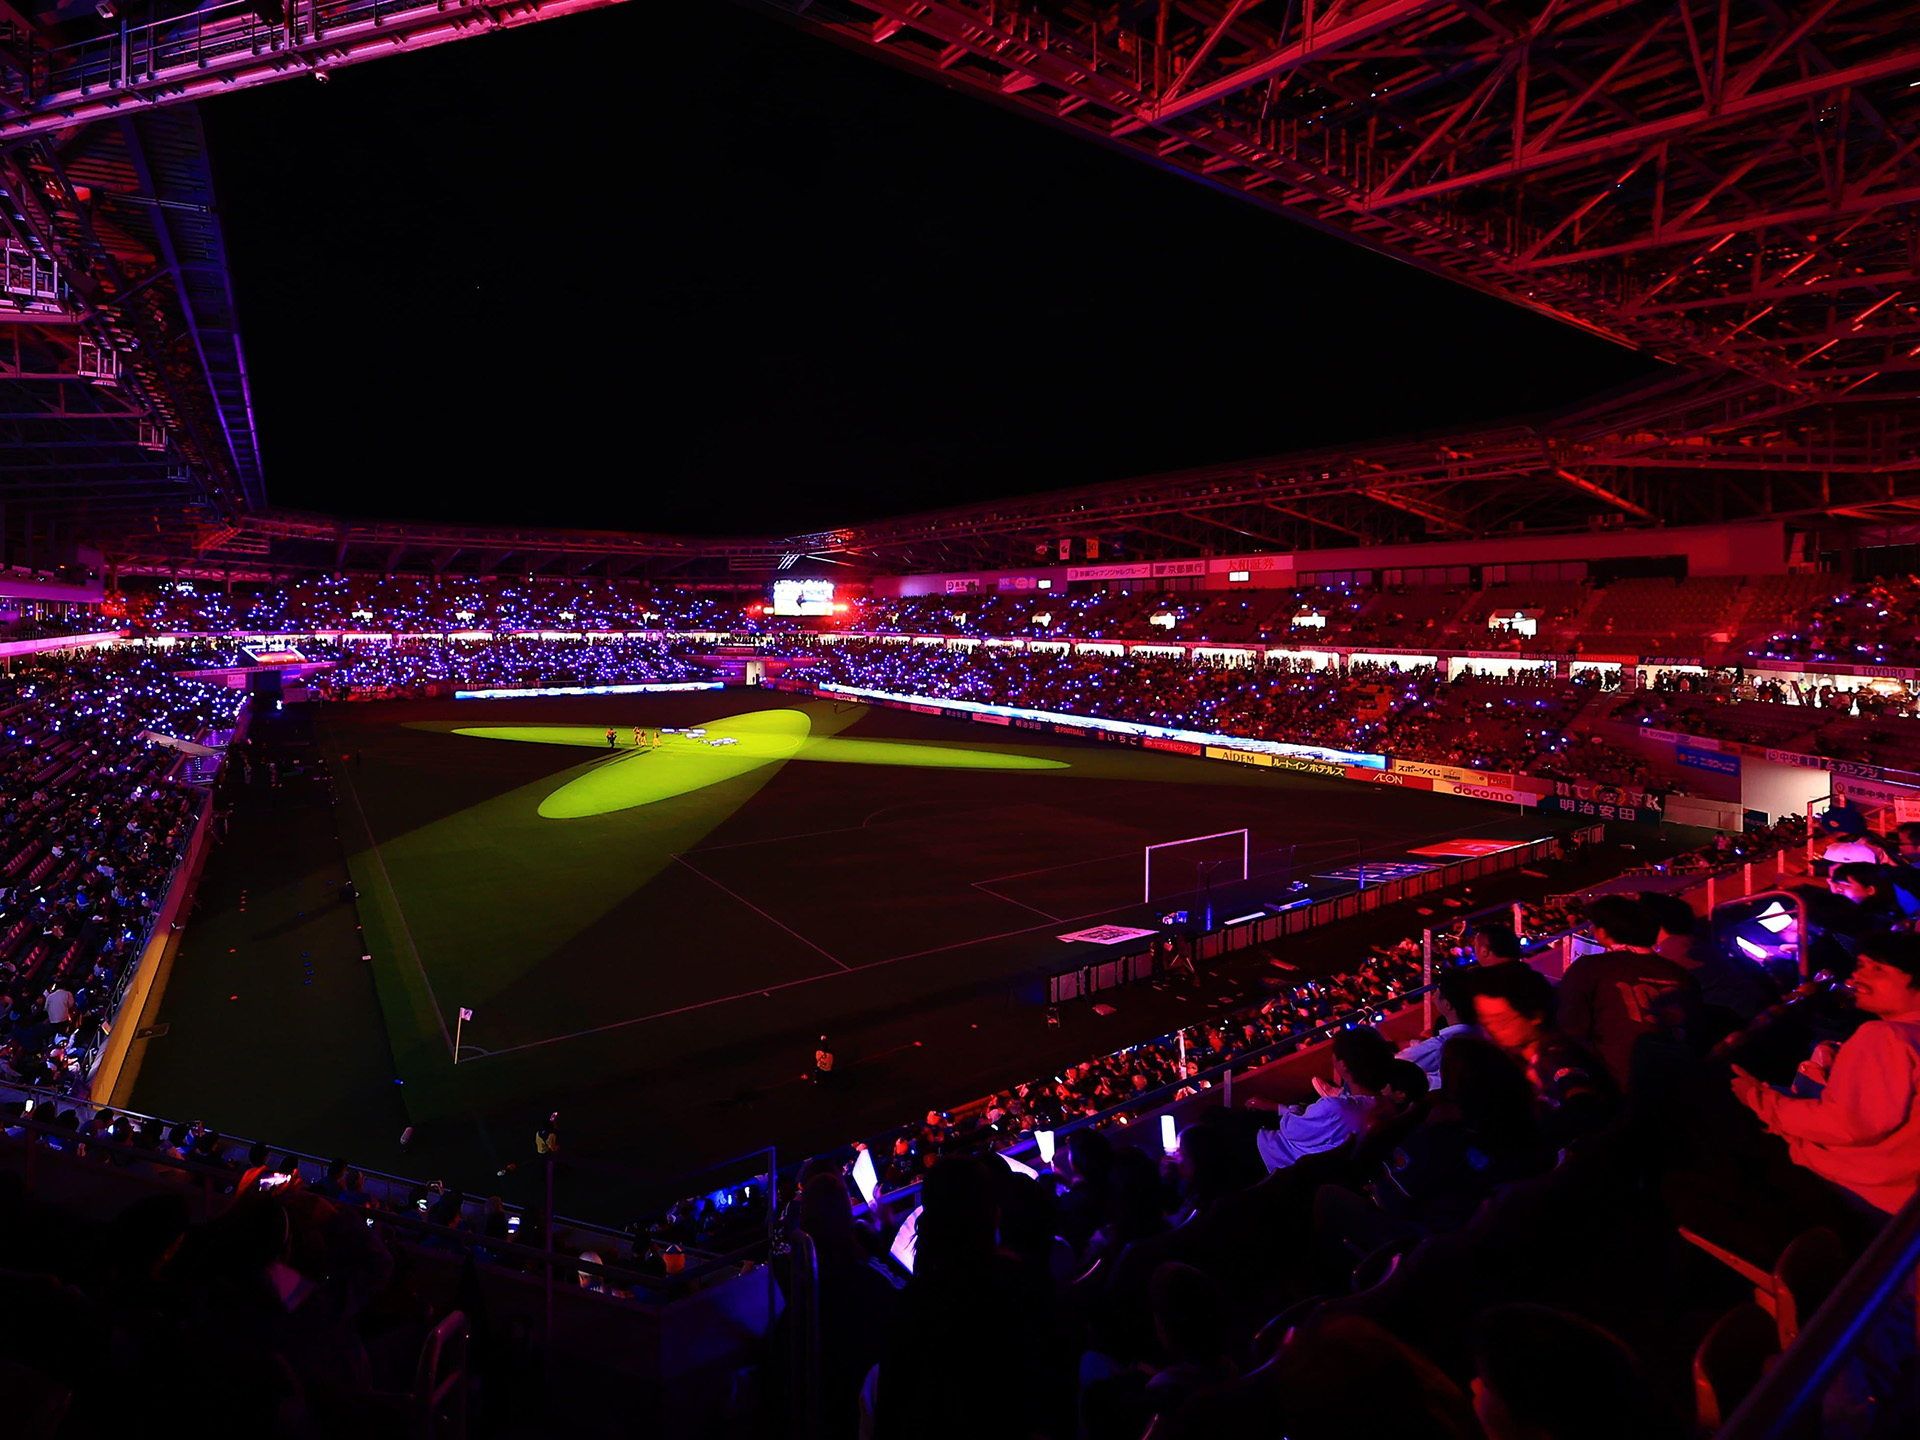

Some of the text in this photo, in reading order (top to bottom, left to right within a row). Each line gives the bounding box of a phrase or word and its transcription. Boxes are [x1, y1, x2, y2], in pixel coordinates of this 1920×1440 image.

[1168, 563, 1203, 574] 京都銀行
[1227, 557, 1274, 571] 大和証券
[1862, 666, 1906, 679] TOYOBO
[1107, 733, 1138, 746] いちご
[1398, 765, 1441, 777] スポーツくじ
[1453, 784, 1514, 802] docomo
[1559, 798, 1635, 821] 明治安田
